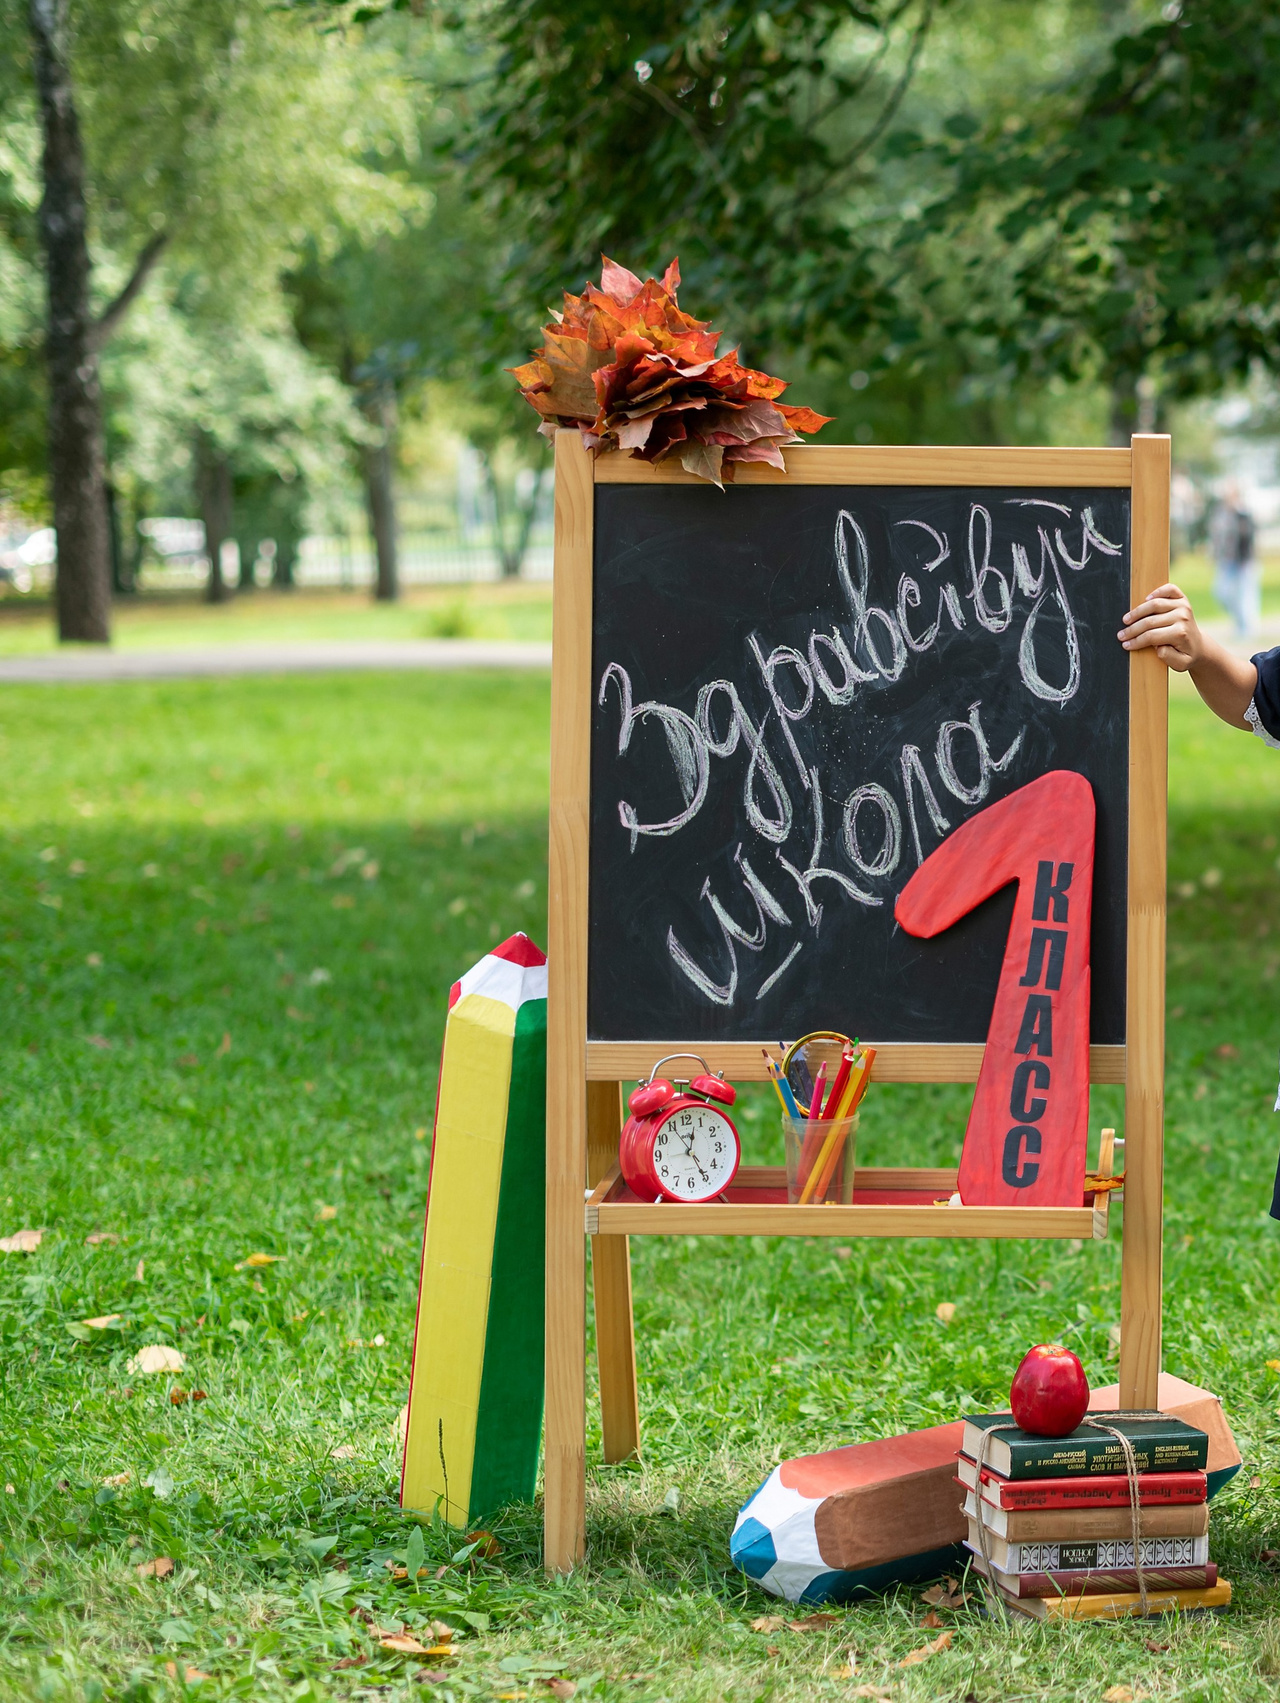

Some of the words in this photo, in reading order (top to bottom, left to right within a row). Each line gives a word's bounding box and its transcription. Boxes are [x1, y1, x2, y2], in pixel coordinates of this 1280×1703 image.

[1002, 860, 1075, 1189] КЛАСС
[667, 1120, 677, 1132] 11
[680, 1114, 693, 1126] 12
[698, 1117, 703, 1127] 1
[709, 1126, 716, 1138] 2
[657, 1133, 668, 1146] 10
[714, 1141, 722, 1153] 3
[654, 1150, 662, 1162] 9
[710, 1158, 717, 1169] 4
[661, 1165, 669, 1177] 8
[702, 1170, 709, 1182] 5
[673, 1175, 680, 1186] 7
[687, 1177, 695, 1188] 6
[1063, 1490, 1113, 1500] Андерсен
